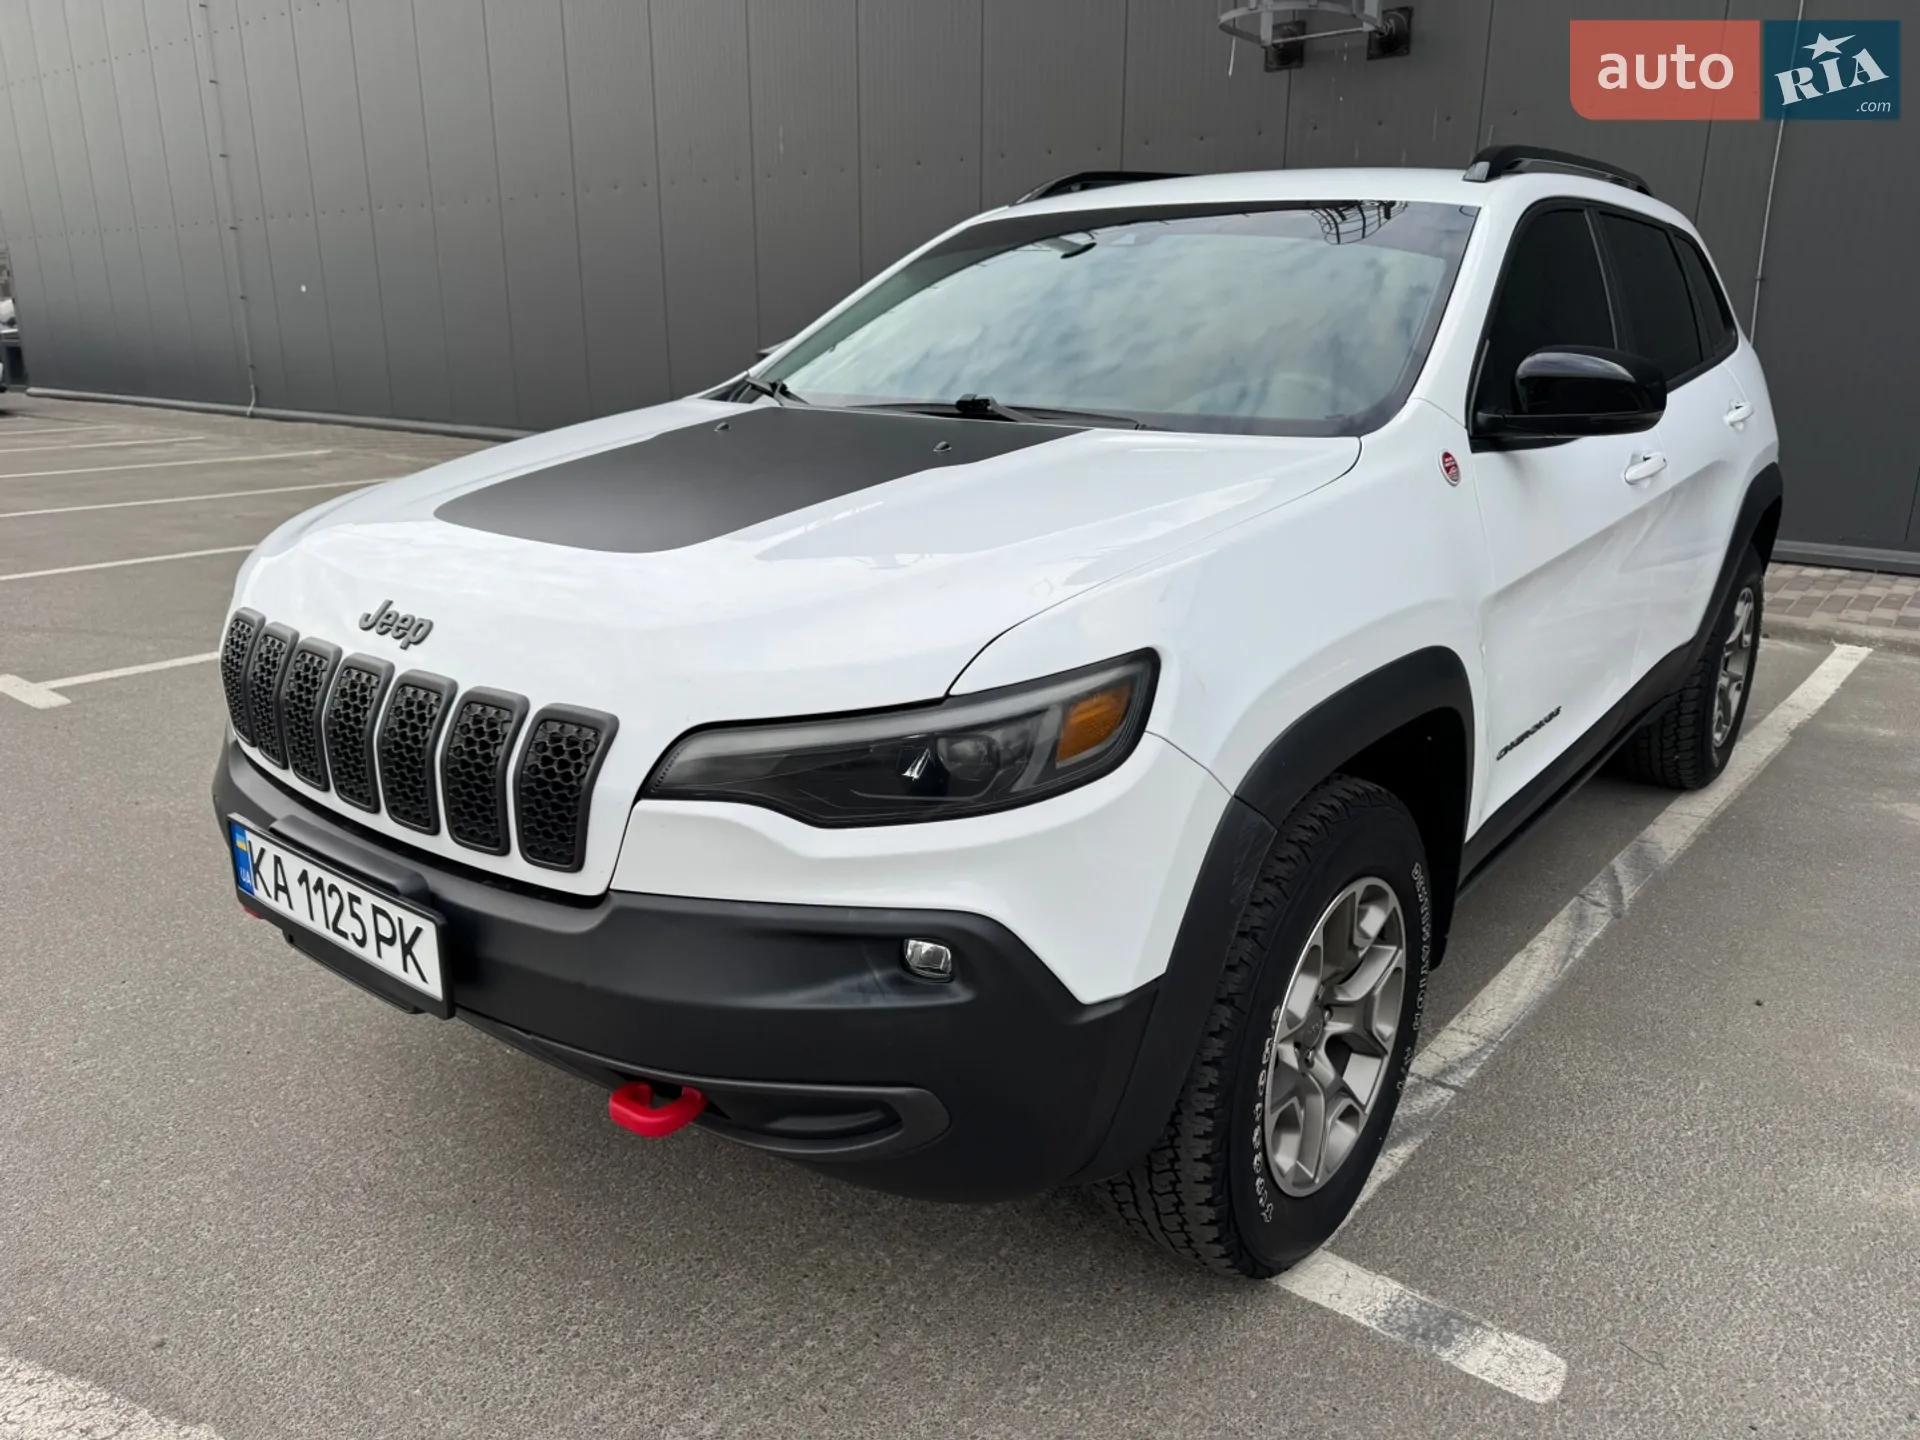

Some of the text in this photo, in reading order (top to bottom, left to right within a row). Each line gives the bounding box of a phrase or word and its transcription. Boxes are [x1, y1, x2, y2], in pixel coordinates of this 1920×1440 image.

[358, 599, 434, 651] Jeep
[248, 840, 429, 985] KA 1125 PK
